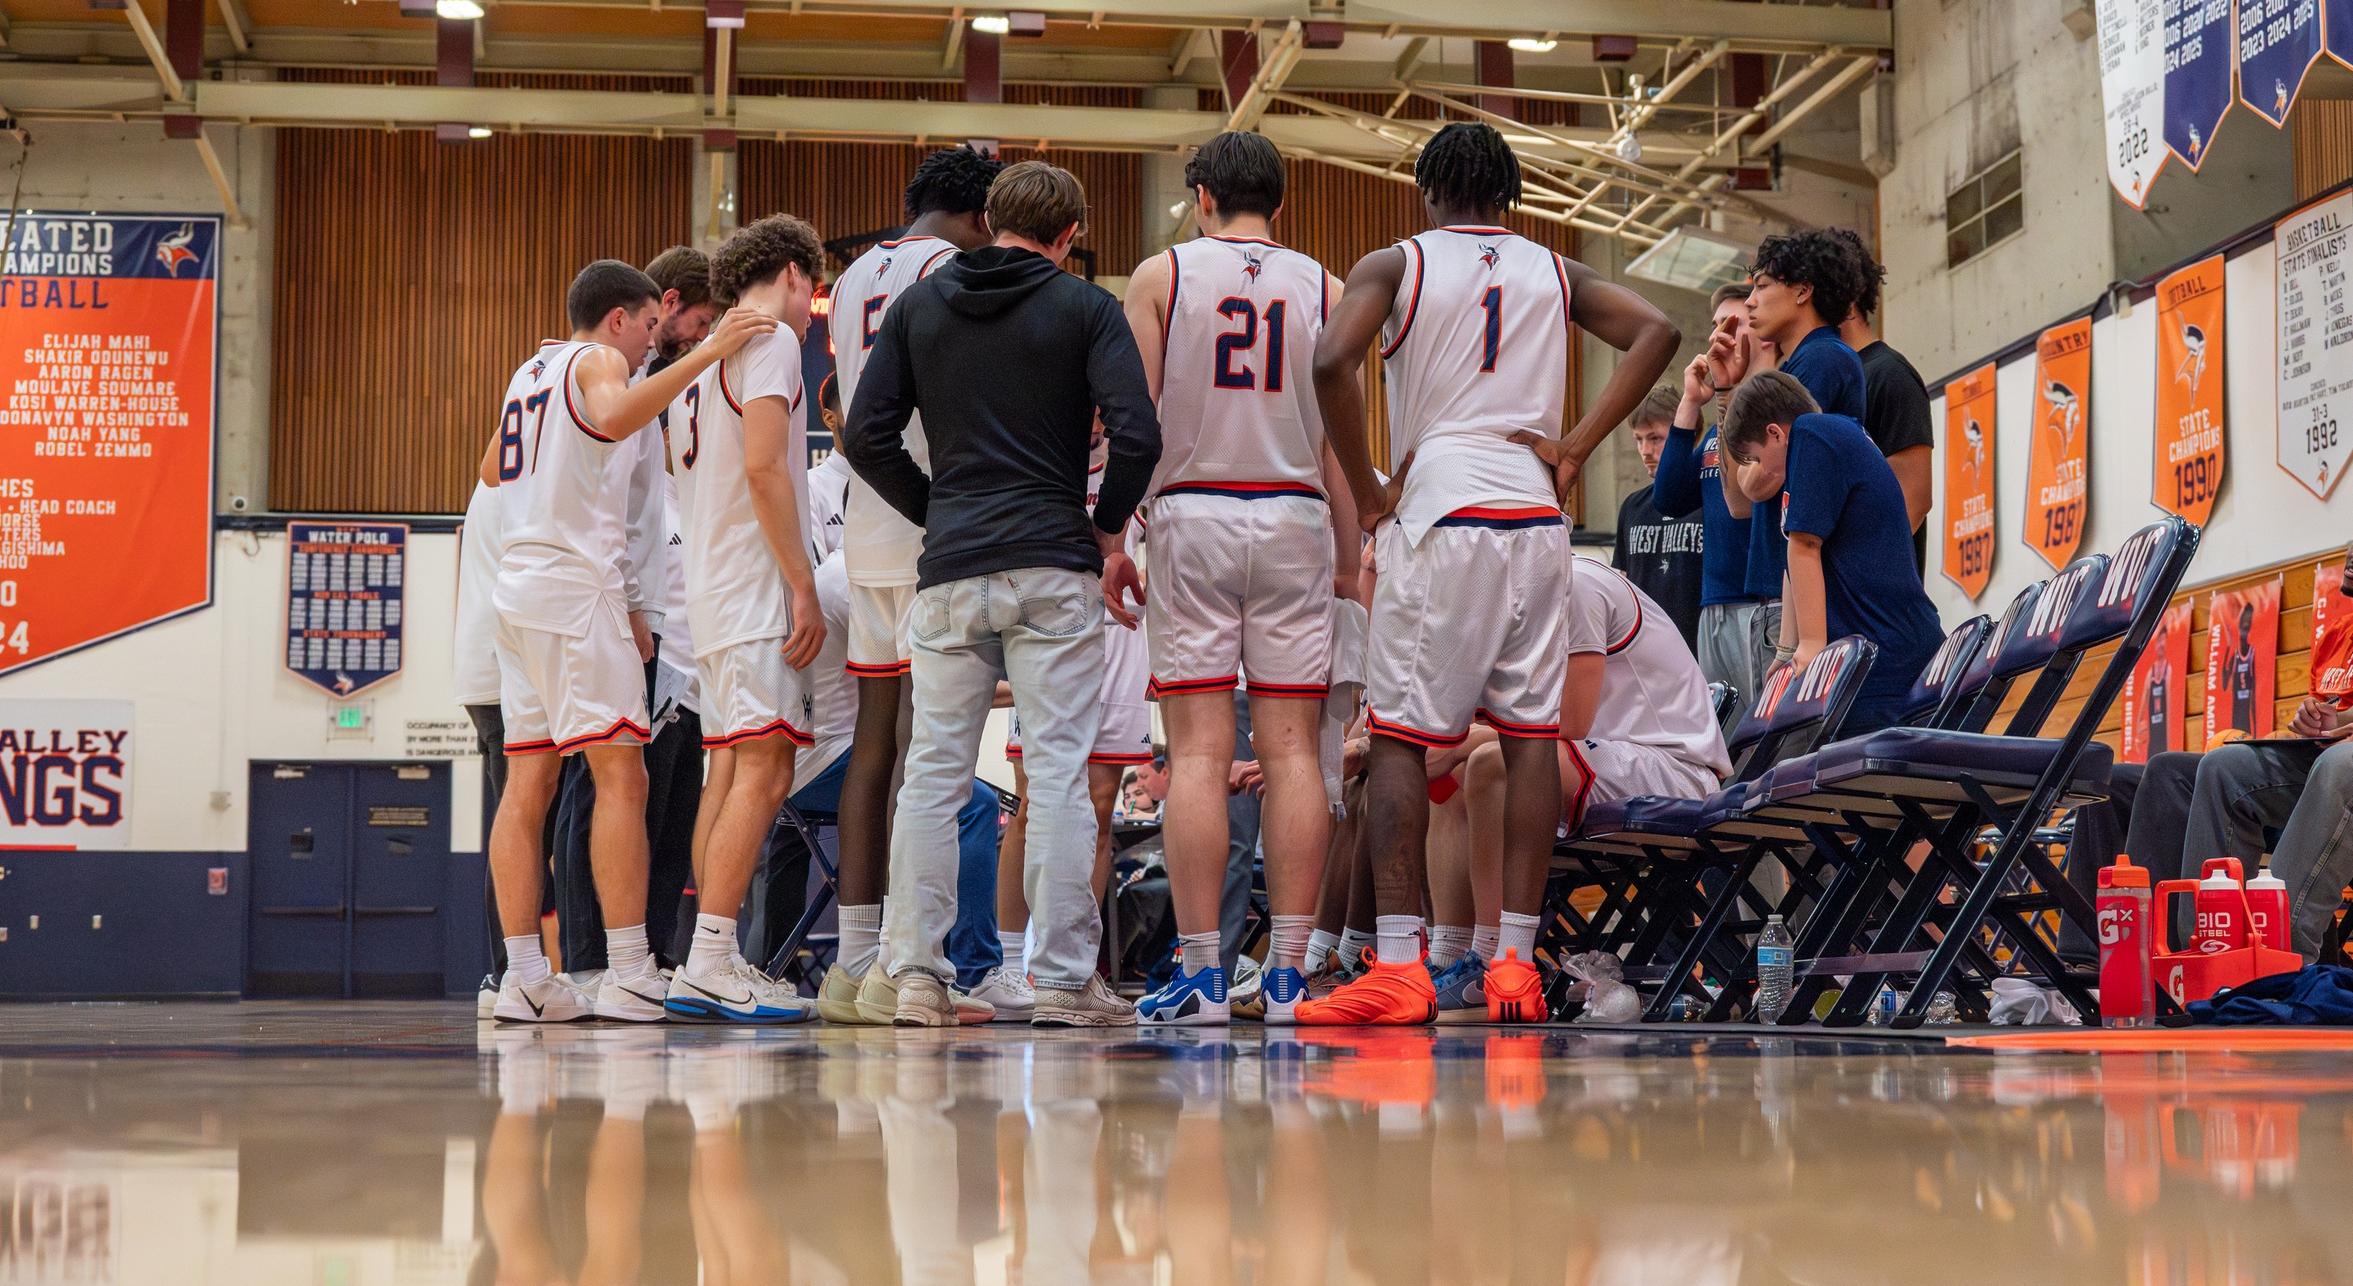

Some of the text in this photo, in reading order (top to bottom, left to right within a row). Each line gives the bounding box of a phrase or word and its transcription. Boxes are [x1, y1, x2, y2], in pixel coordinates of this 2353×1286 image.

[2165, 21, 2181, 48] 006
[2182, 9, 2203, 38] 2020
[2205, 0, 2227, 25] 2022
[2240, 0, 2288, 34] 2006 200
[2240, 1, 2314, 63] 2023 2024 2025
[2165, 35, 2203, 74] 024 2025
[2119, 128, 2149, 168] 2022
[0, 220, 114, 253] EATED
[2287, 212, 2341, 251] BASKETBALL
[3, 252, 113, 275] AMPIONS
[2284, 234, 2347, 277] STATE FINALISTS
[0, 280, 109, 308] TBALL
[43, 334, 150, 350] ELIJAH MAHI
[1213, 296, 1287, 392] 21
[1479, 284, 1503, 373] 1
[24, 349, 83, 364] SHAKIR
[38, 365, 154, 380] AARON RAGEN
[9, 395, 180, 411] KOSI WARREN-HOUSE
[15, 380, 176, 396] MOULAYE SOUMARE
[0, 410, 190, 426] DONAVYN WASHINGTON
[47, 426, 141, 442] NOAH YANG
[500, 386, 553, 482] 87
[682, 382, 700, 470] 3
[2179, 408, 2210, 437] STATE
[34, 441, 153, 457] ROBEL ZEMMO
[2168, 427, 2220, 463] CHAMPIONS
[2306, 419, 2337, 454] 1992
[2174, 453, 2216, 509] 1990
[19, 499, 117, 516] HEAD COACH
[1964, 493, 1986, 517] STATE
[308, 531, 389, 545] WATER POLO
[1629, 525, 1662, 555] WEST
[1662, 523, 1700, 553] VALLEY
[1959, 532, 1990, 577] 1987
[2097, 526, 2166, 608] WVC
[2026, 564, 2091, 637] WVC
[2317, 597, 2327, 620] CJ
[1797, 643, 1850, 703] WVC
[2206, 624, 2221, 740] WILLIAM AMOA
[0, 729, 128, 754] ALLEY
[0, 754, 125, 827] NGS
[2198, 912, 2231, 928] BIO
